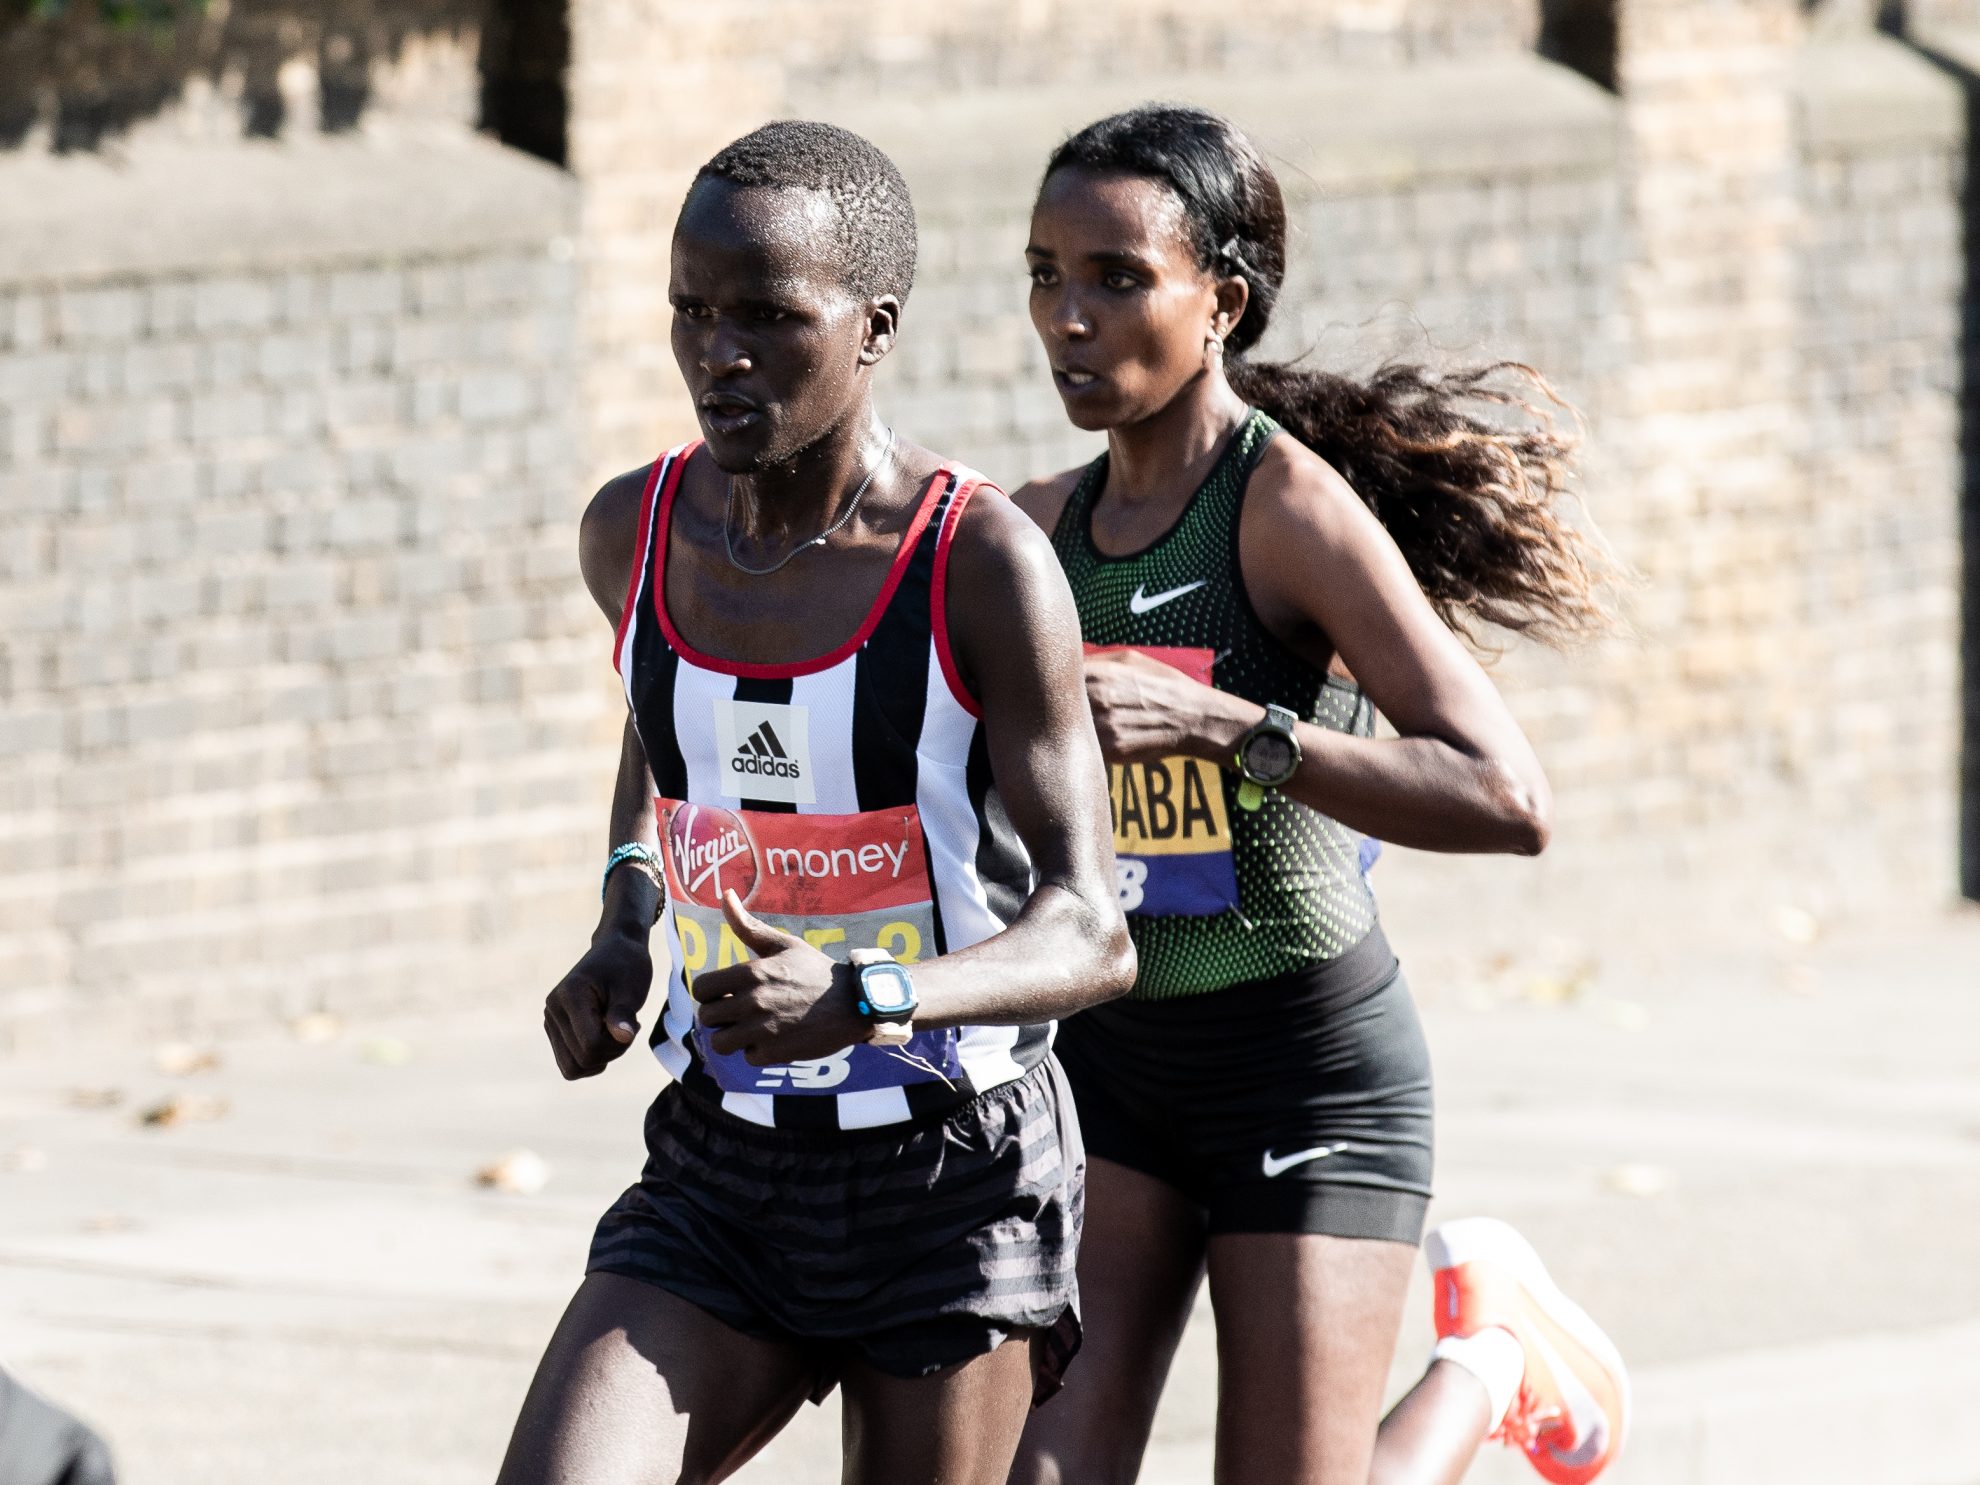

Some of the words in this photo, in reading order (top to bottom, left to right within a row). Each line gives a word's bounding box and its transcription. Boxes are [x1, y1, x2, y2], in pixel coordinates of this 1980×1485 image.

[731, 754, 800, 779] adidas
[675, 804, 749, 900] Virgin
[766, 840, 908, 879] money
